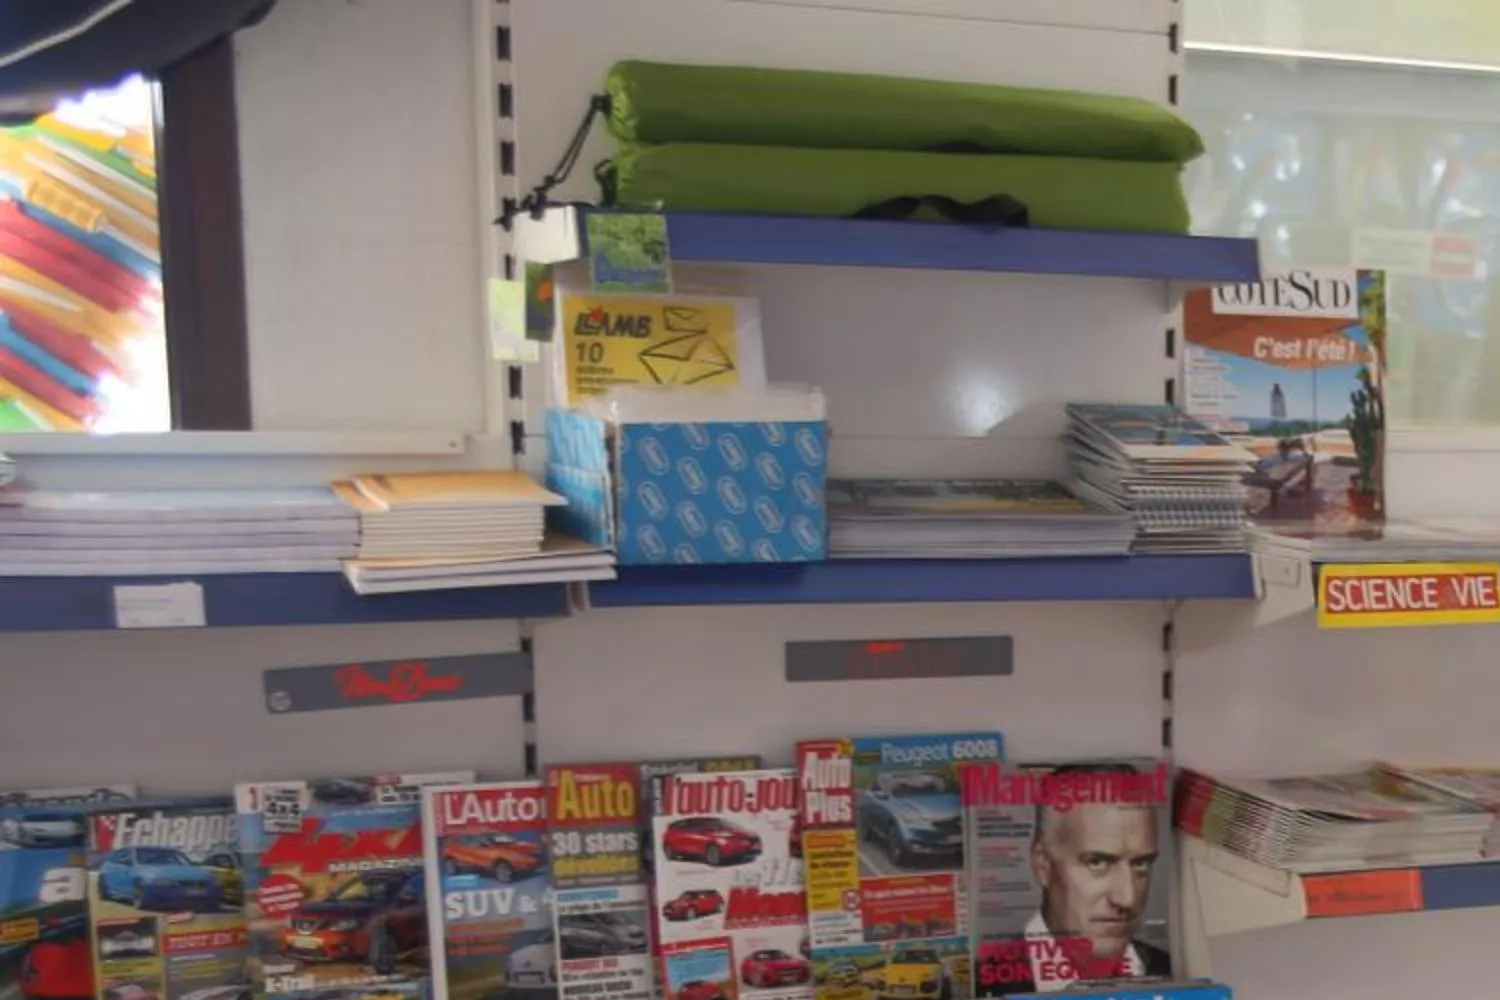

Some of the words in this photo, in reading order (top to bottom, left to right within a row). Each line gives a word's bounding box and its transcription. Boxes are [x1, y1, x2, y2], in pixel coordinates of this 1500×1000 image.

[575, 342, 605, 364] 10
[1253, 337, 1301, 359] C'est
[1327, 577, 1439, 612] SCIENCE
[1451, 576, 1497, 609] VIE
[880, 742, 949, 767] Peugeot
[802, 752, 851, 791] Auto
[959, 757, 1170, 813] Management
[556, 769, 636, 821] Auto
[805, 789, 853, 824] Plus
[586, 830, 640, 853] stars
[444, 887, 516, 919] SUV
